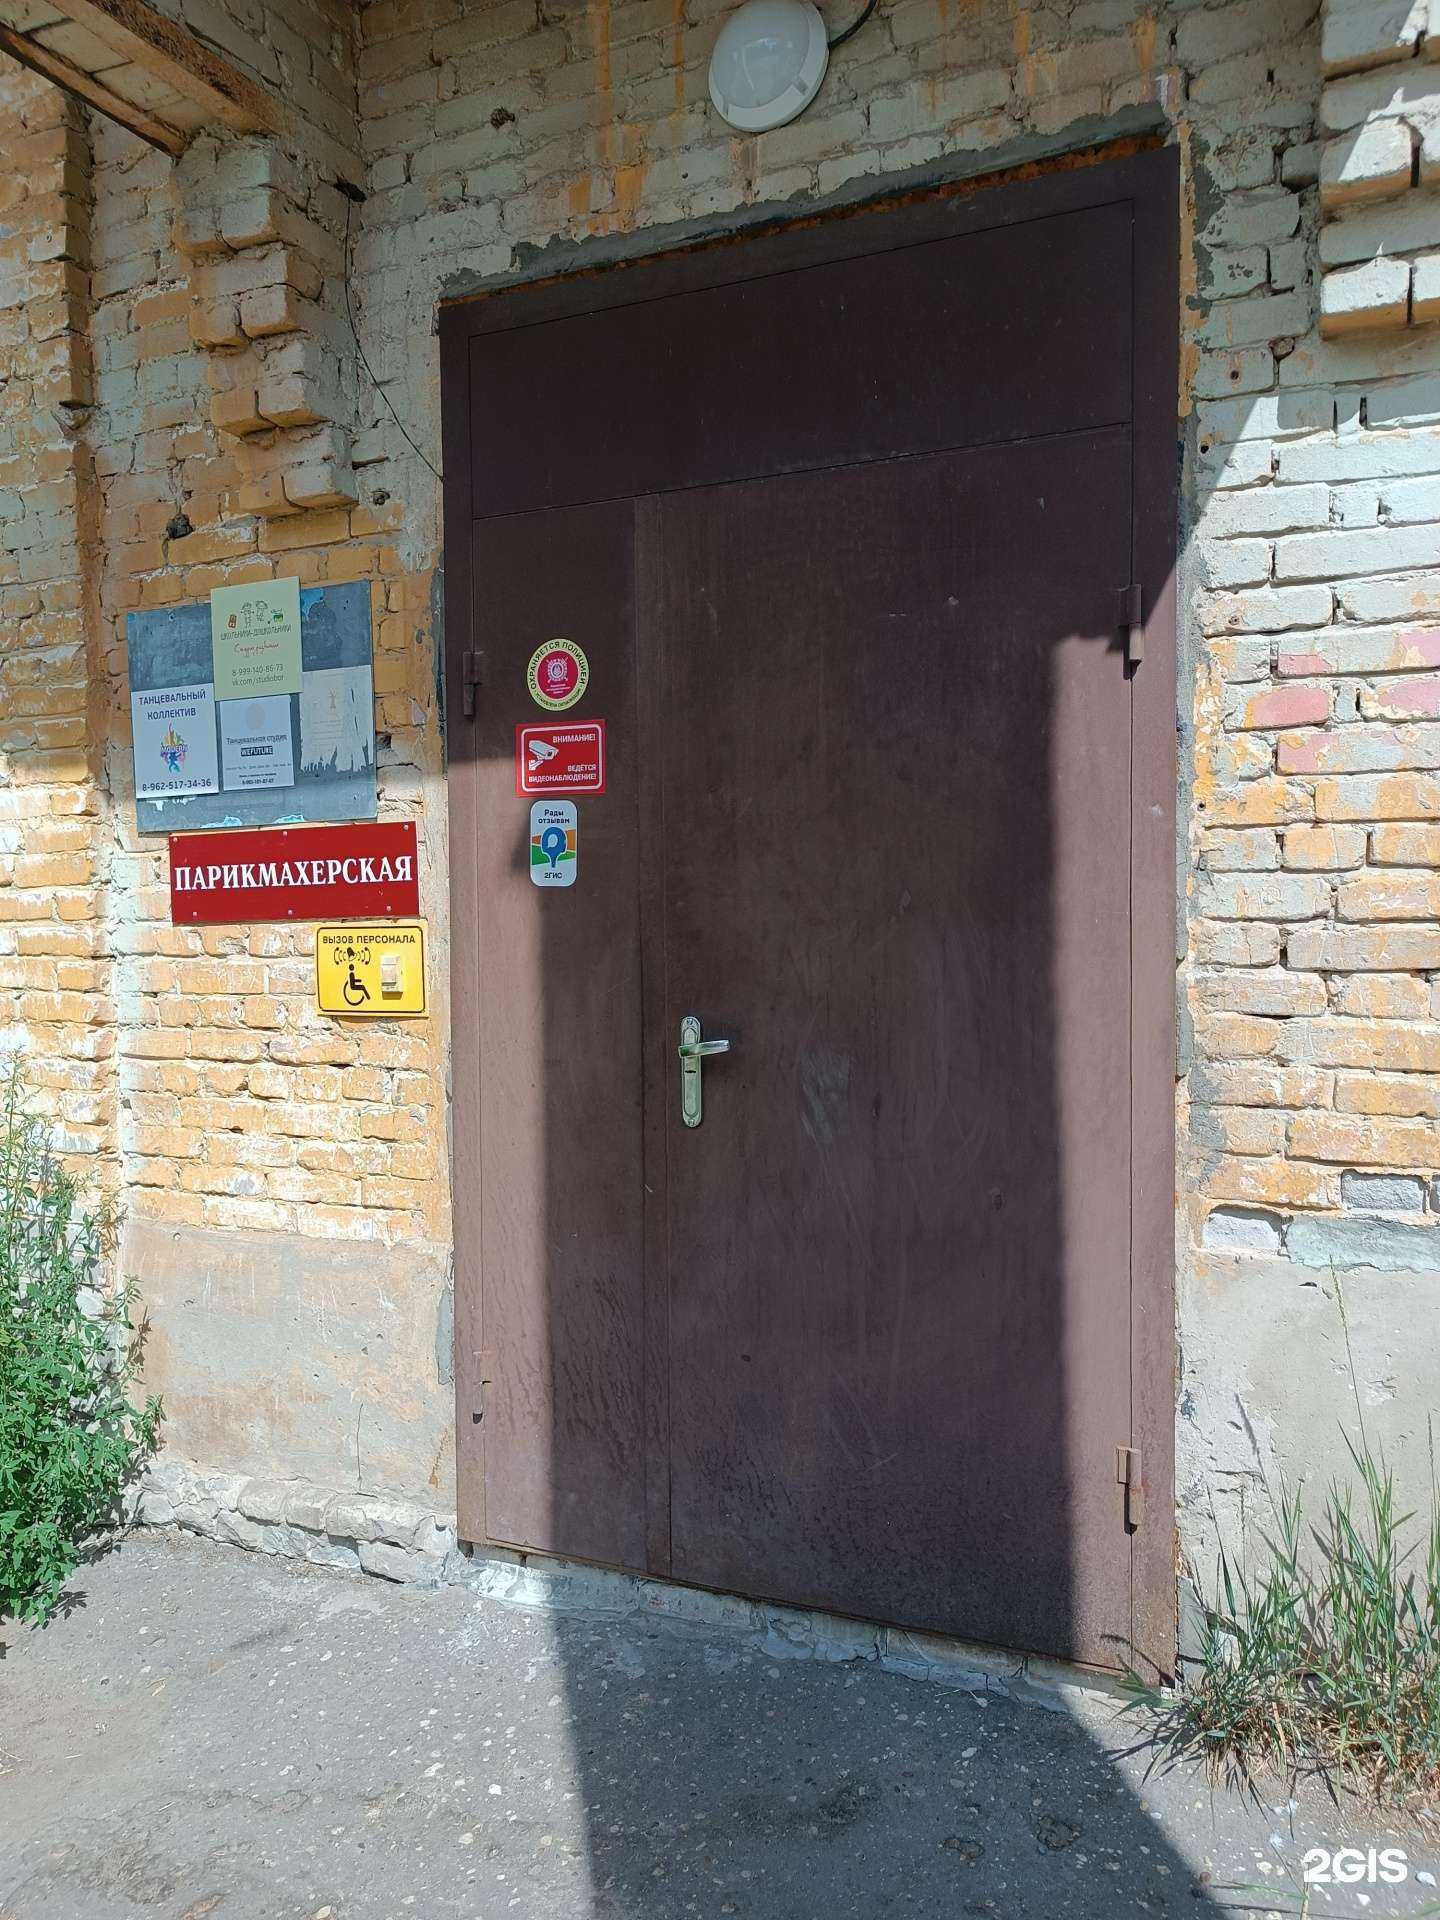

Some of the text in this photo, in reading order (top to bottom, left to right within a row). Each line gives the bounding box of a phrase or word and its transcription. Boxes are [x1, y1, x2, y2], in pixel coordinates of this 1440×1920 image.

[529, 641, 587, 690] ОХРАНЯЕТСЯ ПОЛИЦИЕЙ
[138, 689, 206, 706] ТАНЦЕВАЛЬНЫЙ
[147, 707, 197, 721] КОЛЛЕКТИВ
[552, 733, 596, 744] ВНИМАНИЕ!
[528, 773, 596, 784] ВИДЕОНАБЛЮДЕНИЕ!
[142, 778, 212, 792] 8-962-517-34-36
[544, 809, 564, 818] Рады
[174, 855, 413, 892] ПАРИКМАХЕРСКАЯ
[544, 872, 563, 880] 2ГИС
[322, 934, 416, 945] ВЫЗОВ ПЕРСОНАЛА
